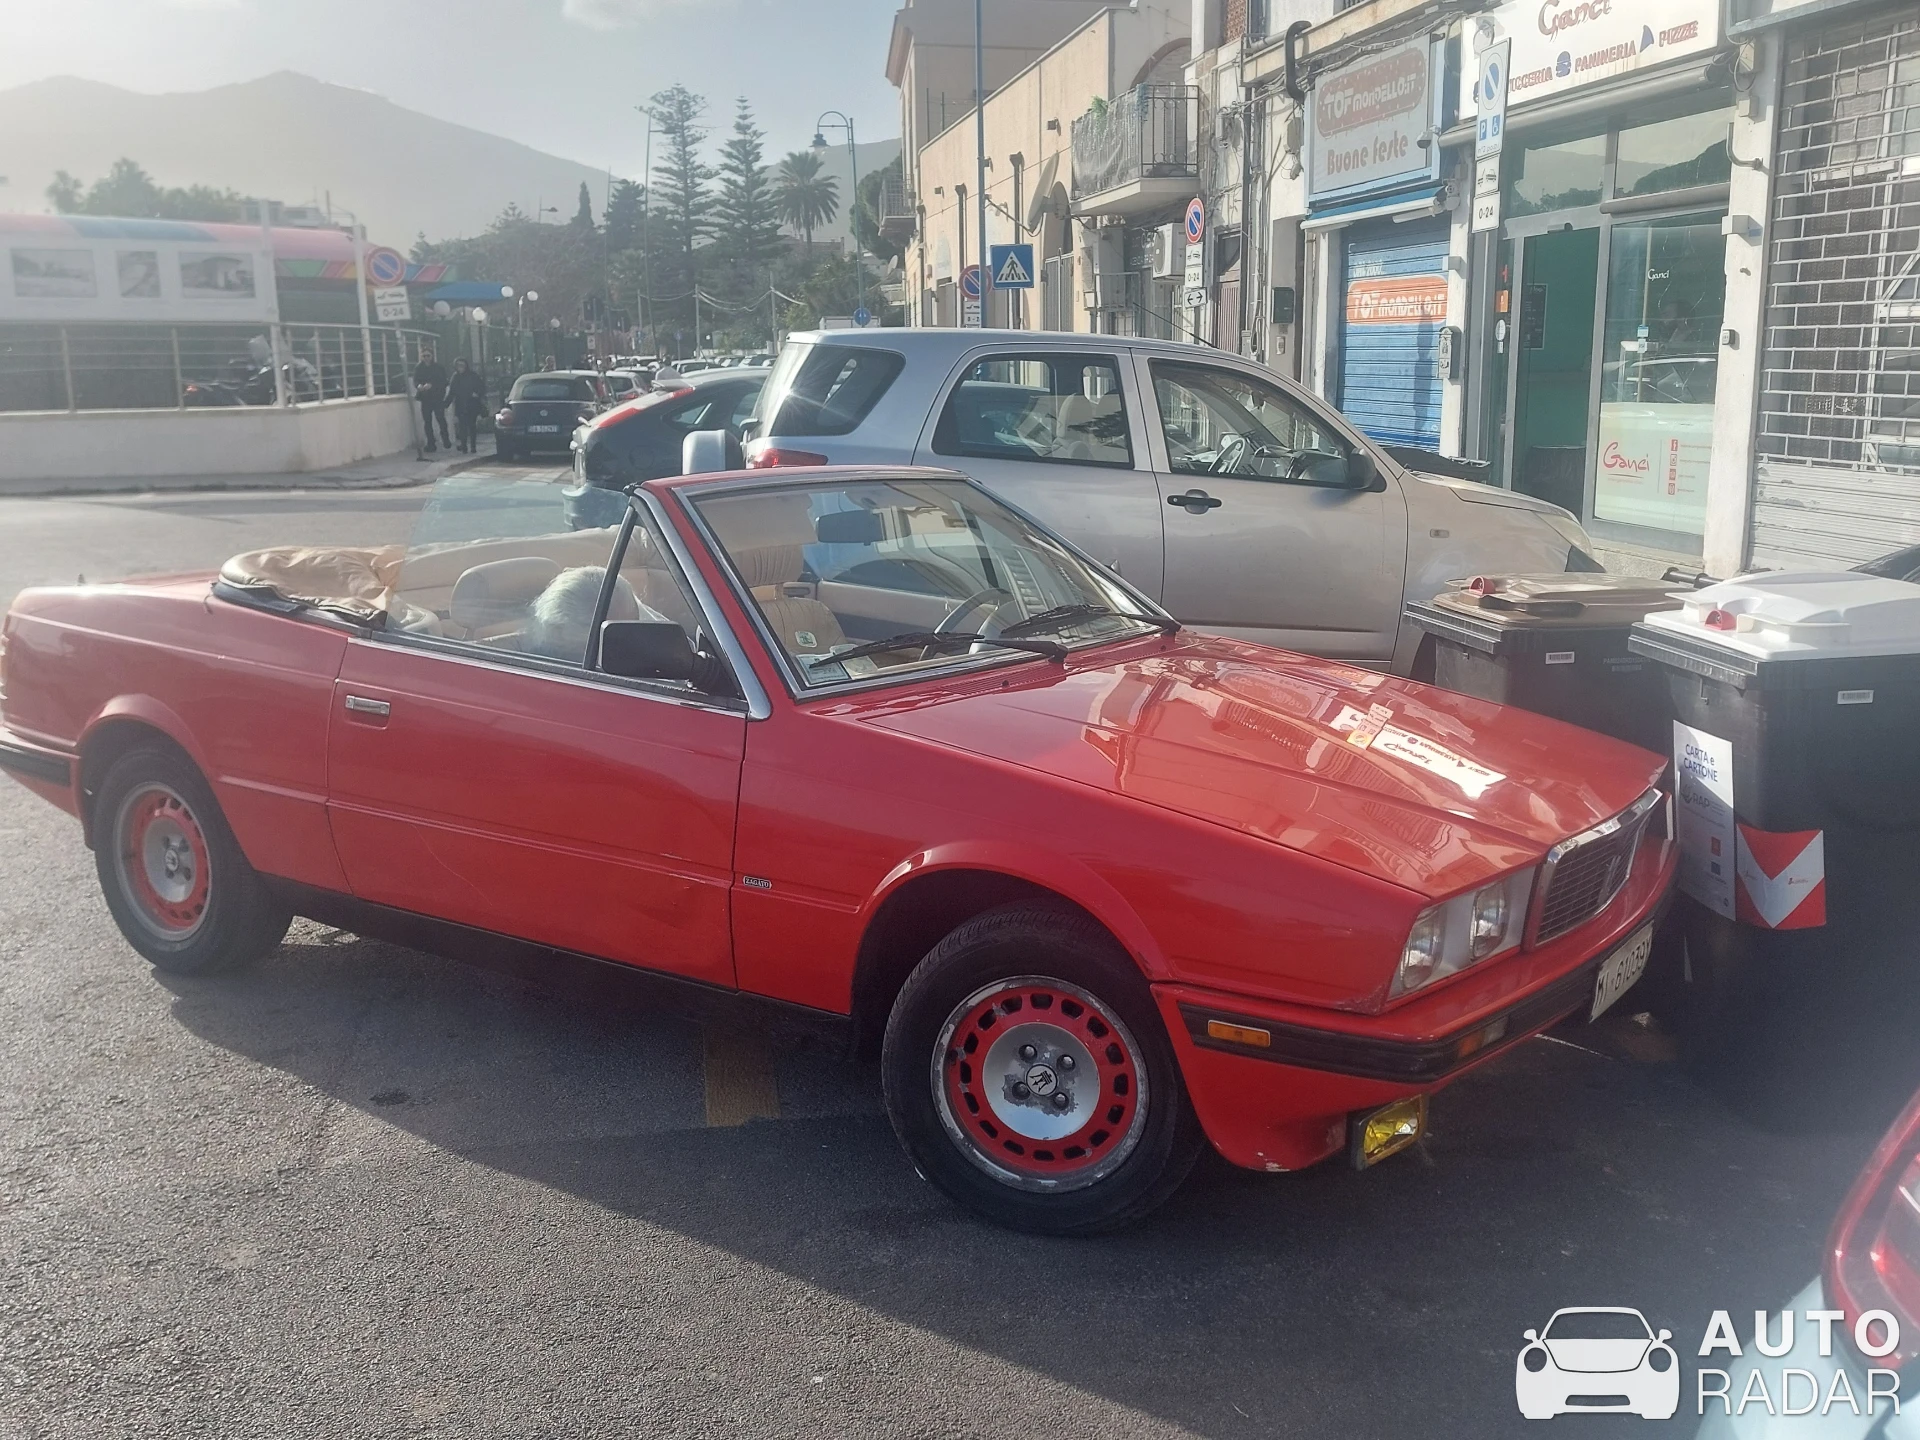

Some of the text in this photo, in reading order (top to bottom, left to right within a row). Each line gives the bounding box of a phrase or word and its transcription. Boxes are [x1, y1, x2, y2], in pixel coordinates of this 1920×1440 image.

[1508, 67, 1553, 93] ICCERIA
[1574, 40, 1636, 73] PANINERIA
[1327, 130, 1409, 175] Buone feste
[1478, 206, 1494, 219] 0-24
[1187, 272, 1200, 282] 0-24
[1647, 268, 1670, 281] Ganci
[383, 308, 404, 317] 0-24
[1603, 441, 1650, 472] Ganci
[1685, 744, 1715, 766] CARTA e
[1683, 757, 1718, 782] CARTONE
